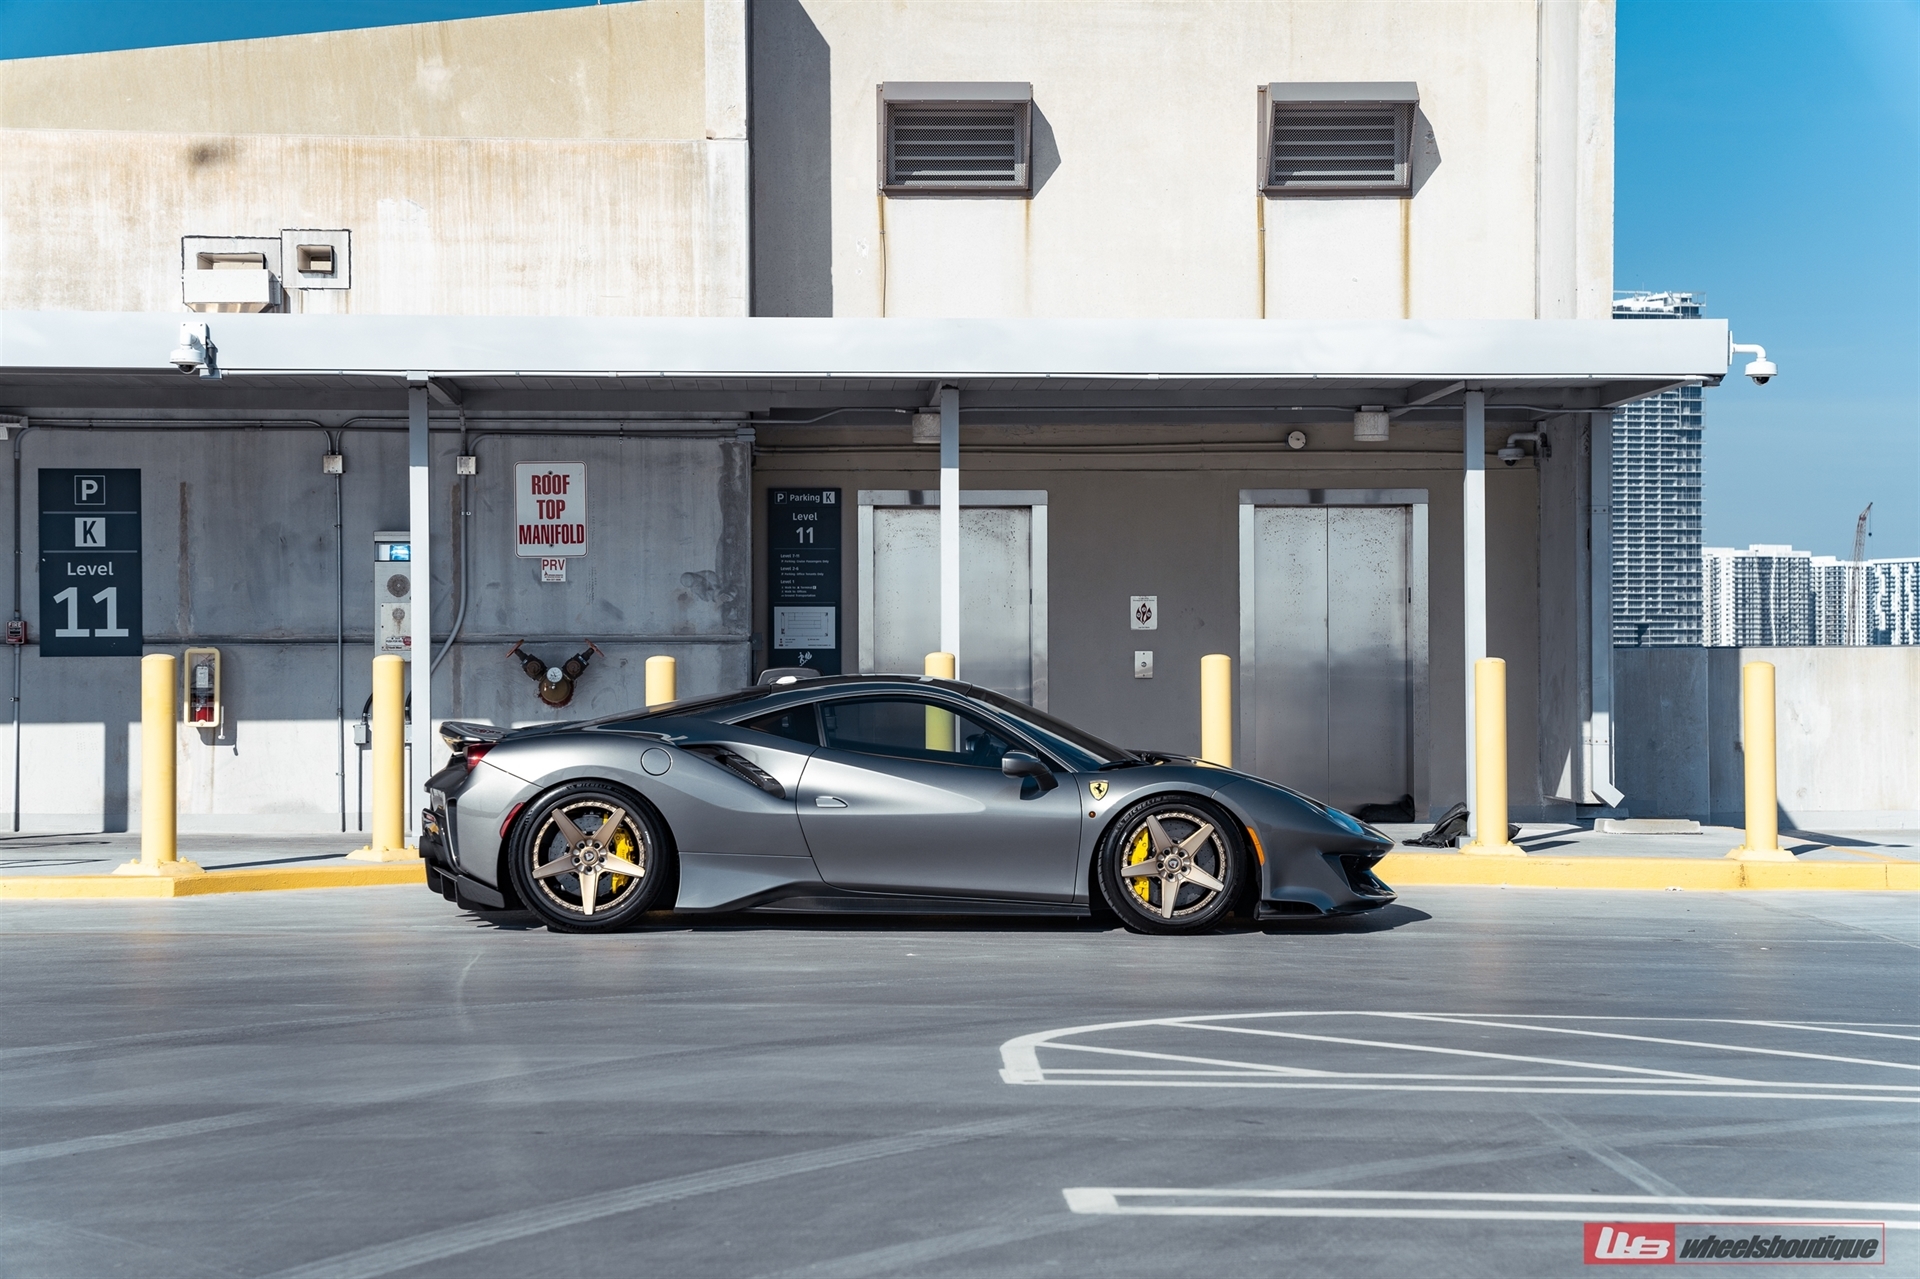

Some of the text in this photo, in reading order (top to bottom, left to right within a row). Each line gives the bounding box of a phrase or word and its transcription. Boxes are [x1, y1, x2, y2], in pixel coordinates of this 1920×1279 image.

[81, 479, 98, 500] P
[531, 474, 570, 495] ROOF
[777, 493, 832, 503] P Parking K
[536, 499, 566, 520] TOP
[792, 512, 818, 521] Level
[82, 520, 97, 544] K
[519, 524, 585, 545] MANIFOLD
[796, 526, 814, 544] 11
[67, 561, 114, 577] Level
[542, 559, 566, 571] PRV
[53, 586, 130, 638] 11
[1124, 796, 1162, 822] MICHELIN
